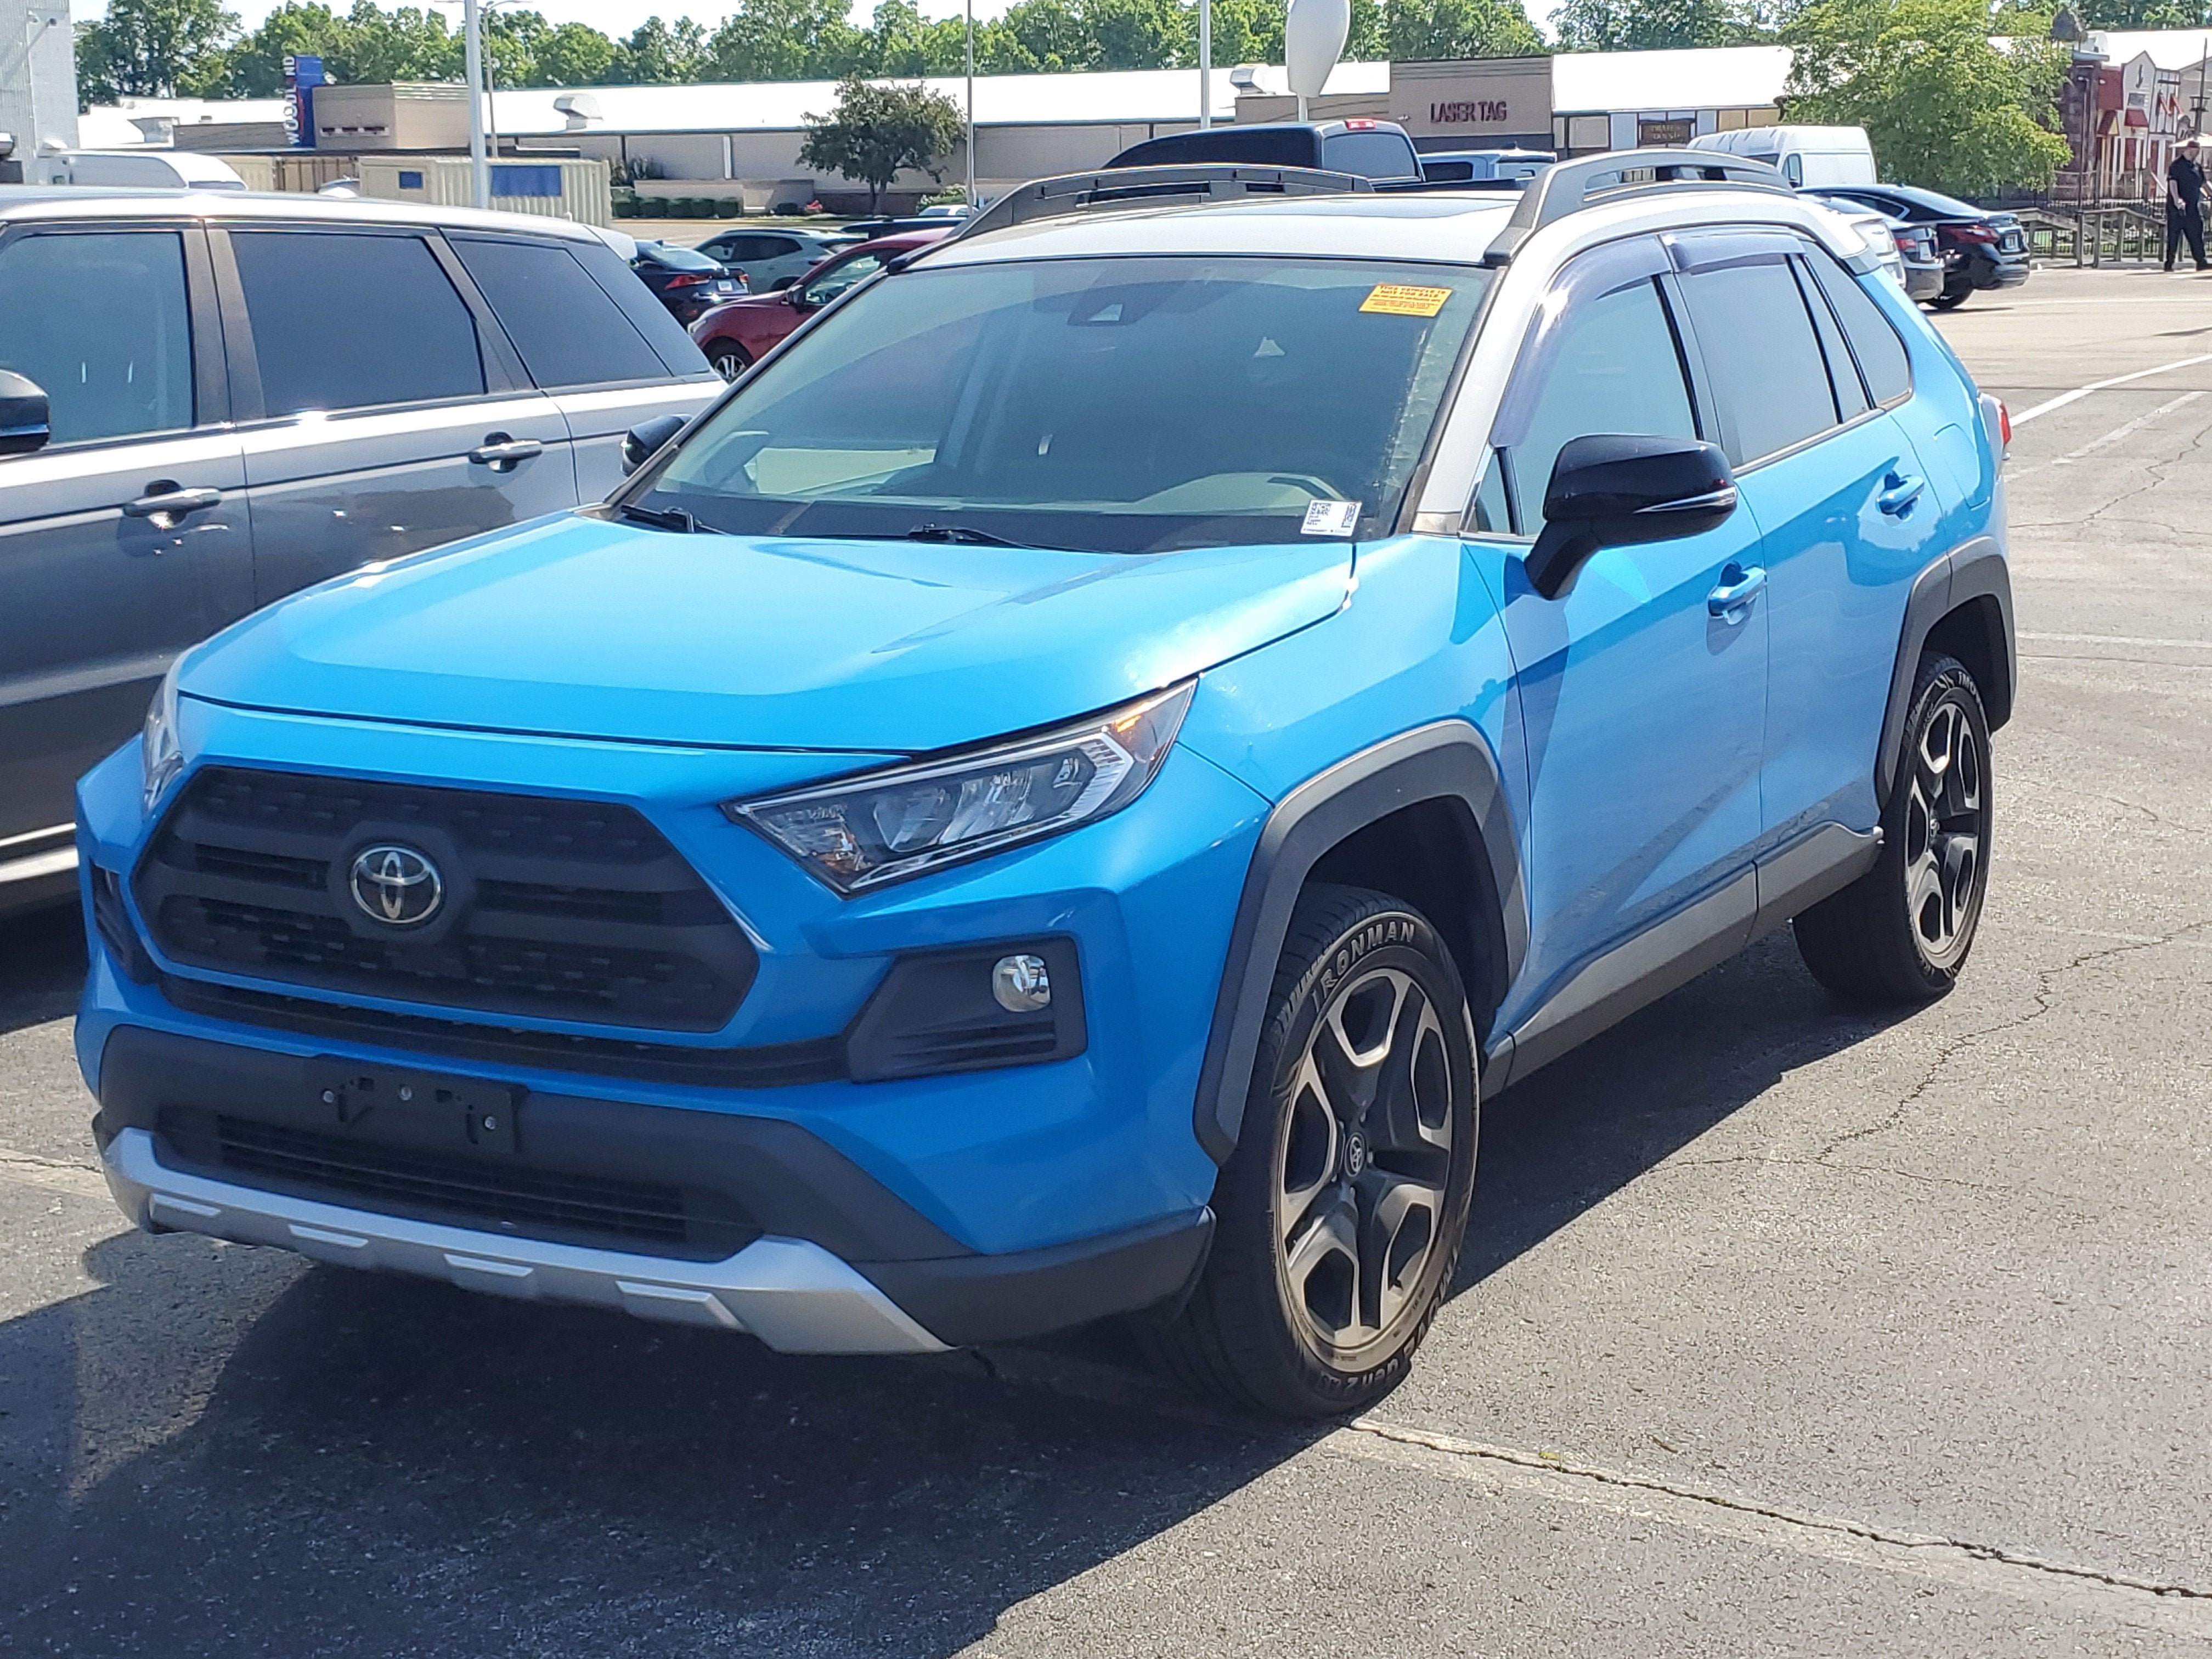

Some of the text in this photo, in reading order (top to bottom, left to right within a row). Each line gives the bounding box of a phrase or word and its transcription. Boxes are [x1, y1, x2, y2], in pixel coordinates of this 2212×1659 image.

[1430, 101, 1507, 123] LASER TAG
[1312, 921, 1415, 1014] IRONMAN
